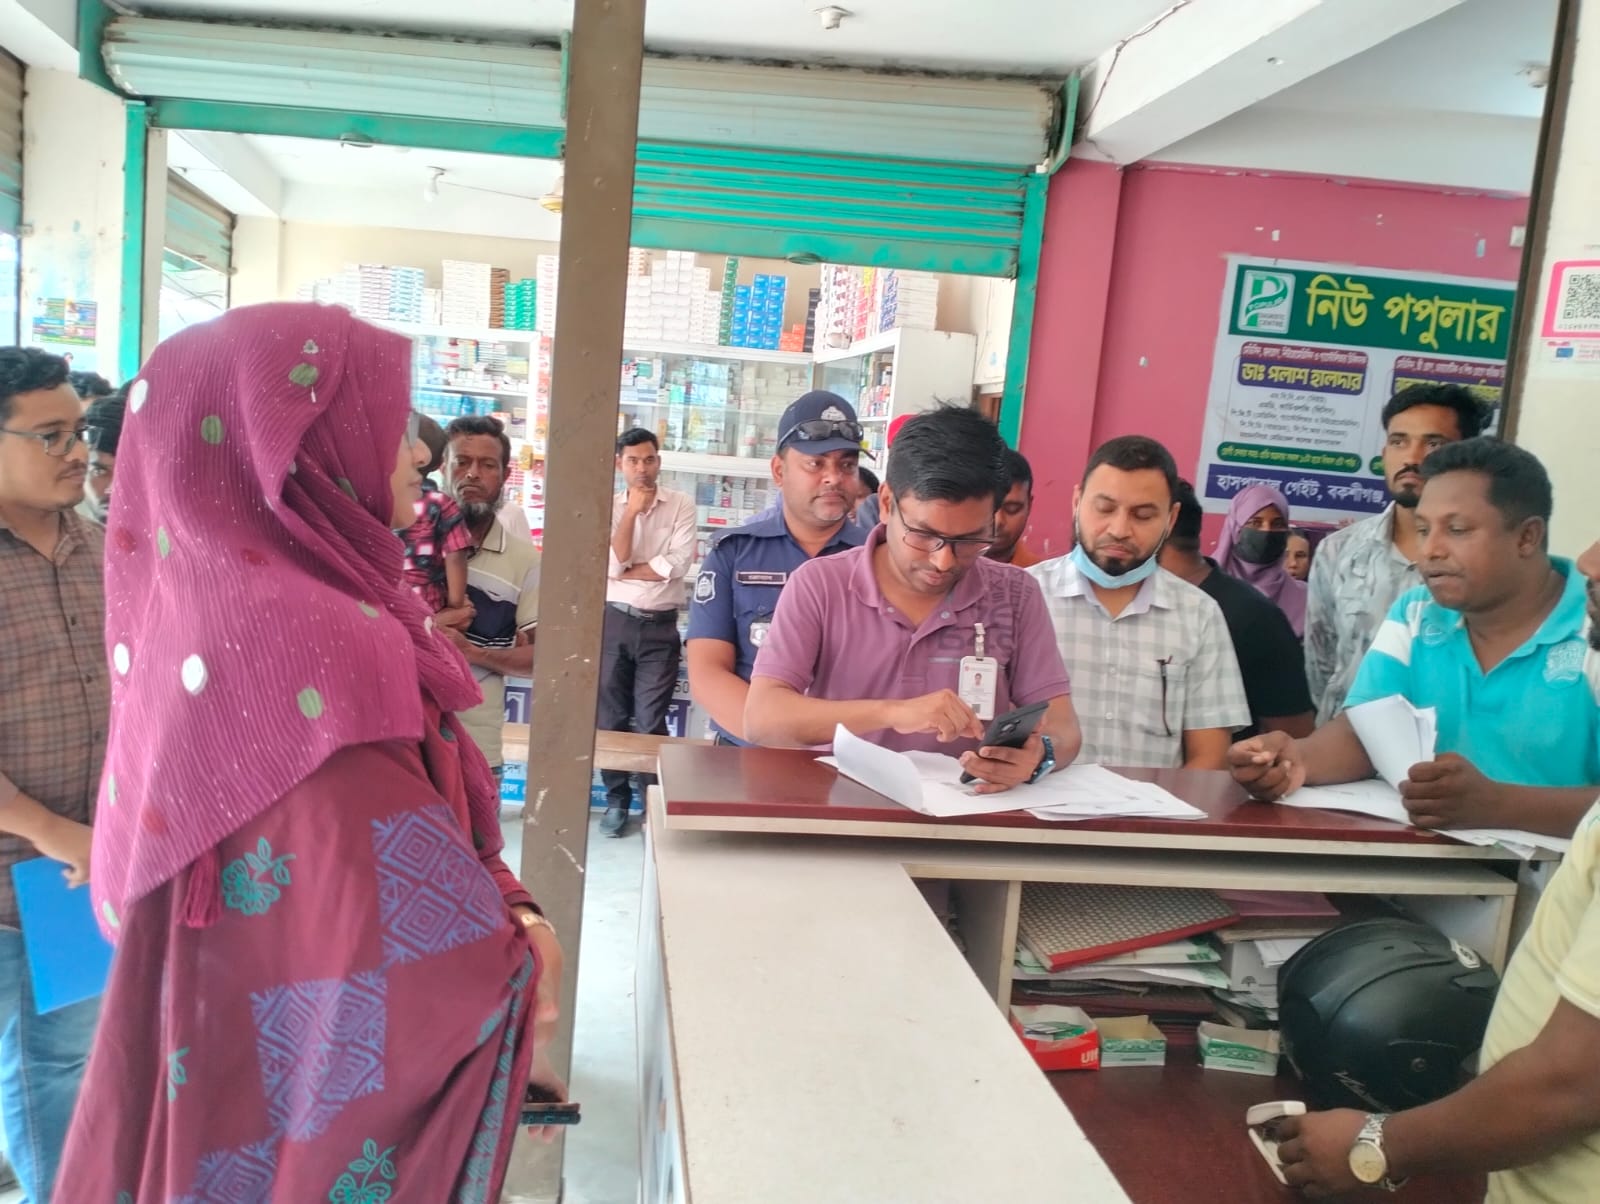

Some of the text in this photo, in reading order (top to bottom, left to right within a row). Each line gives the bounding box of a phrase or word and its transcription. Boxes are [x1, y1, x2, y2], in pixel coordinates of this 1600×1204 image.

[1305, 274, 1506, 350] নিউ পপুলার
[1267, 365, 1310, 385] পলাশ
[1310, 369, 1364, 391] হালদার
